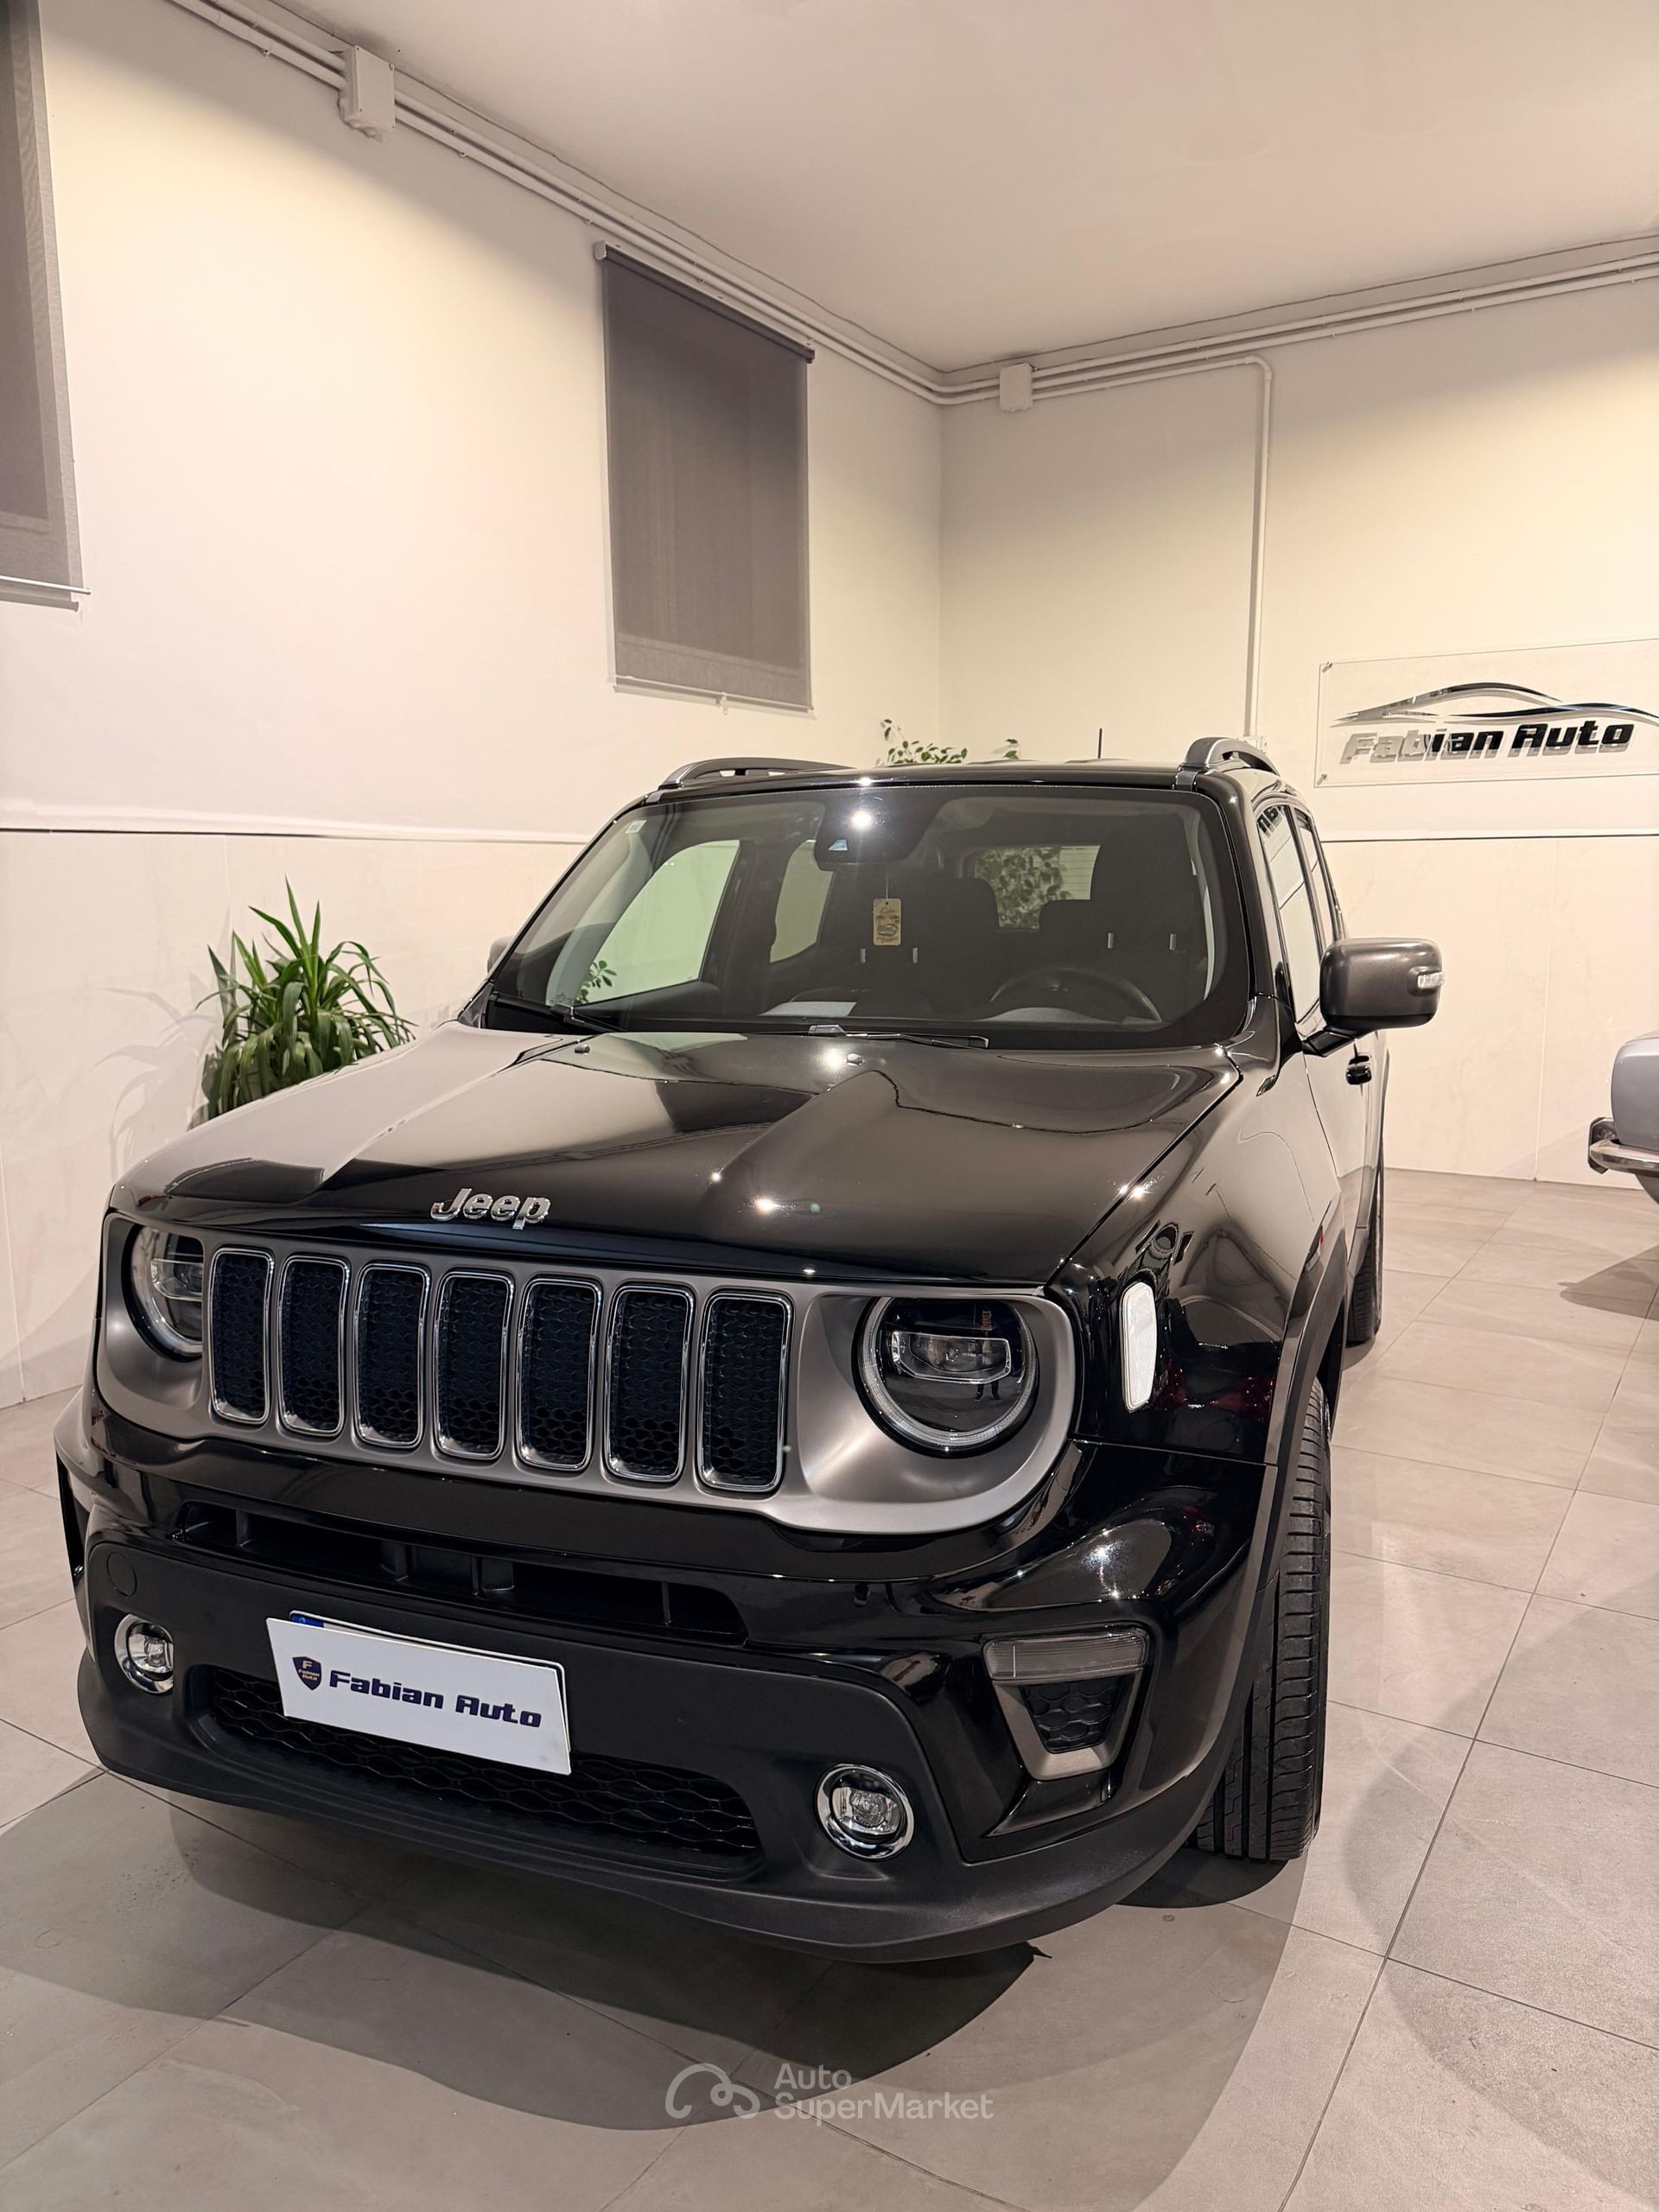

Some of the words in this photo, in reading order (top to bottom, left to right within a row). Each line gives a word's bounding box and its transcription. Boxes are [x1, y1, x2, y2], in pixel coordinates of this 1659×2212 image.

[1341, 728, 1504, 761] Fabian
[1510, 721, 1635, 754] Auto
[430, 1188, 551, 1230] Jeep
[329, 1670, 444, 1709] Fabian
[455, 1694, 542, 1727] Auto
